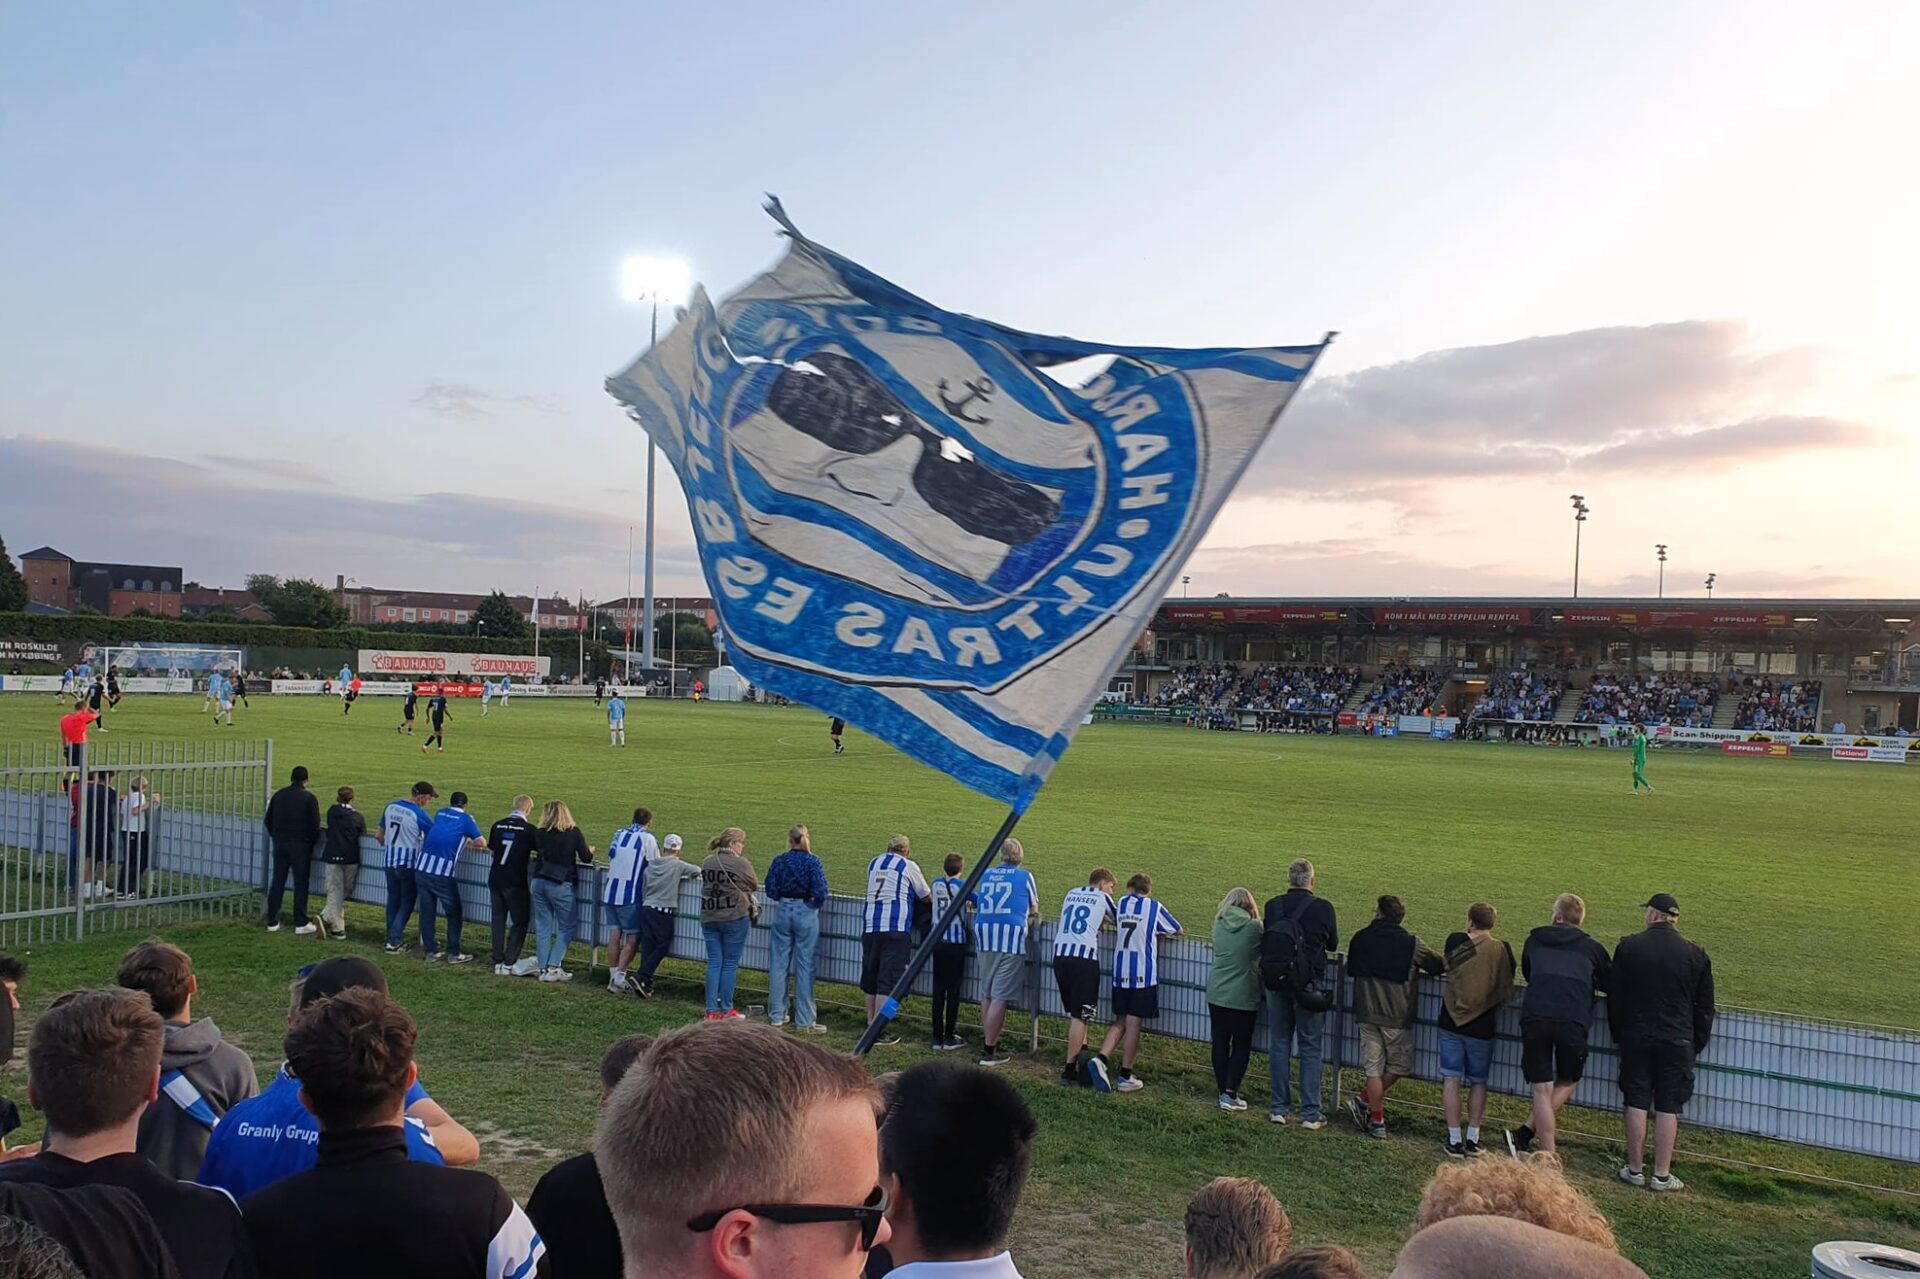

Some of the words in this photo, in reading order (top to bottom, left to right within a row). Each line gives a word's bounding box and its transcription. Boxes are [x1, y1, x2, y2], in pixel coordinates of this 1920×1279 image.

[1409, 611, 1426, 620] MÅL
[14, 642, 59, 651] ROSKILDE
[8, 652, 54, 661] NYKØBING
[384, 656, 445, 671] BAUHAUS
[481, 660, 536, 673] BAUHAUS
[1728, 744, 1764, 752] ZEPPELIN
[390, 821, 401, 845] 7
[500, 839, 514, 865] 7
[701, 869, 736, 883] ROCK
[710, 883, 722, 898] &
[875, 878, 886, 900] 7
[701, 896, 736, 910] ROLL
[979, 881, 1013, 914] 32
[1066, 895, 1097, 905] HANSEN
[1063, 904, 1091, 935] 18
[1121, 922, 1137, 949] 7
[238, 1121, 283, 1143] Granly
[286, 1124, 320, 1145] Grup
